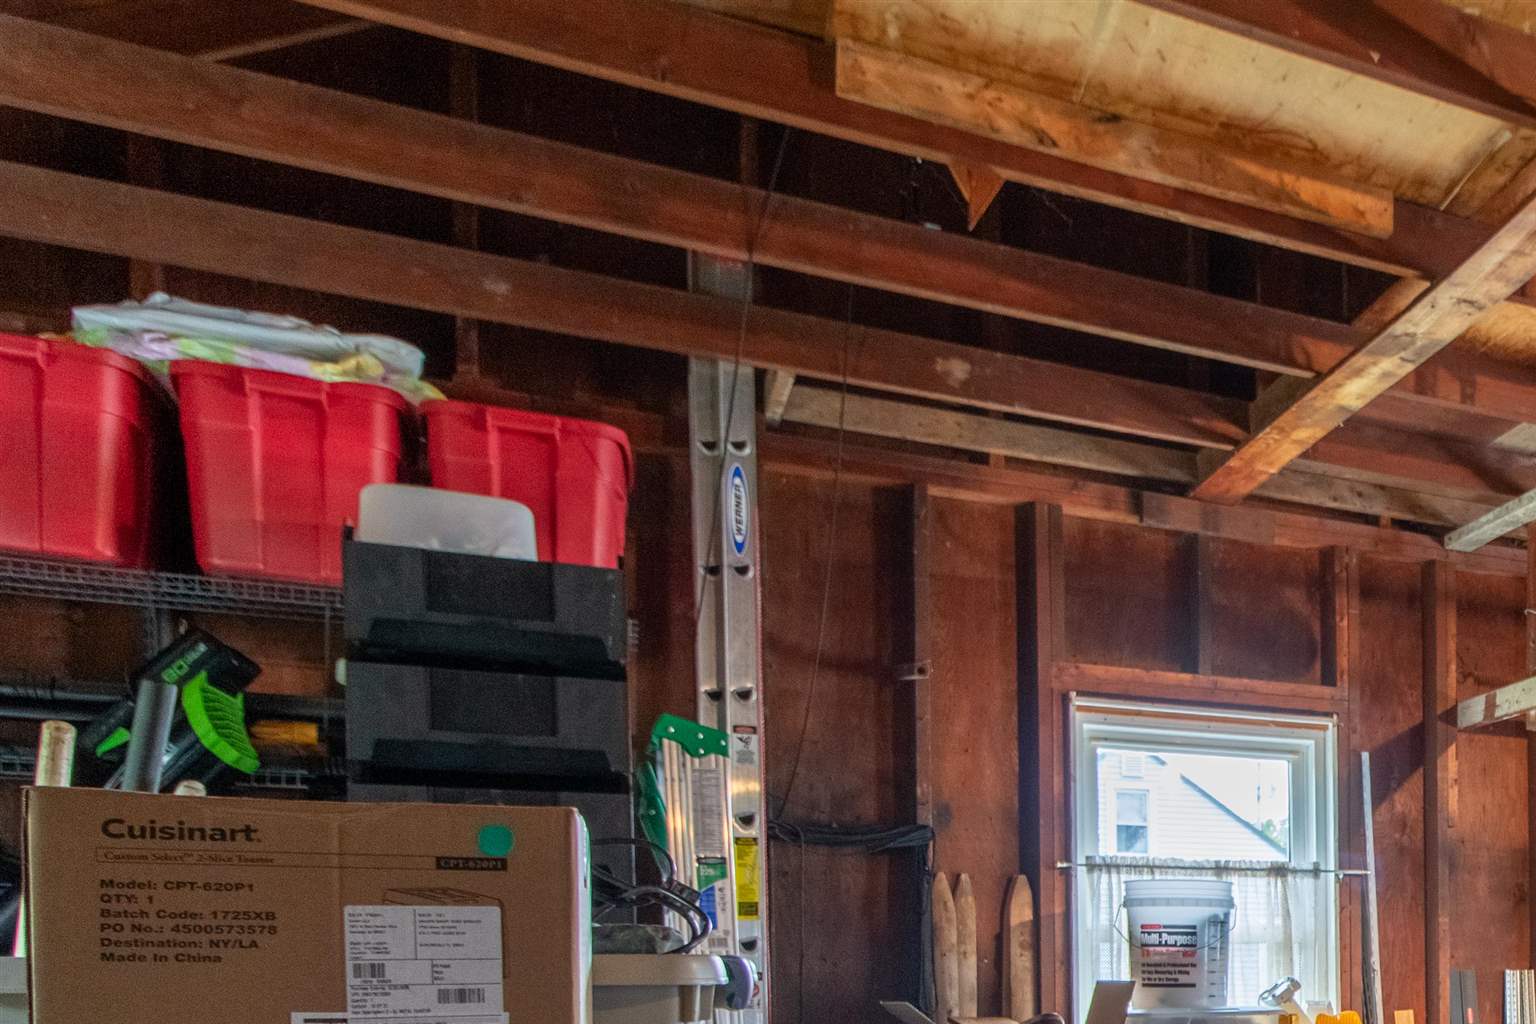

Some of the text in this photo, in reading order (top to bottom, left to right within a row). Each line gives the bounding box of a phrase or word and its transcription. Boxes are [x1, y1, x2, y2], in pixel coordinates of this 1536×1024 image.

[735, 484, 744, 537] WERNER
[101, 817, 259, 842] Cuisinart
[100, 880, 254, 891] Model: CPT-620P1
[100, 894, 138, 904] QTY:
[100, 909, 277, 921] Batch Code: 1725XB
[100, 923, 125, 933] PO
[100, 938, 259, 949] Destination: NY/LA
[1141, 932, 1197, 947] Multi-Purpose
[100, 953, 147, 962] Made
[175, 953, 223, 963] China
